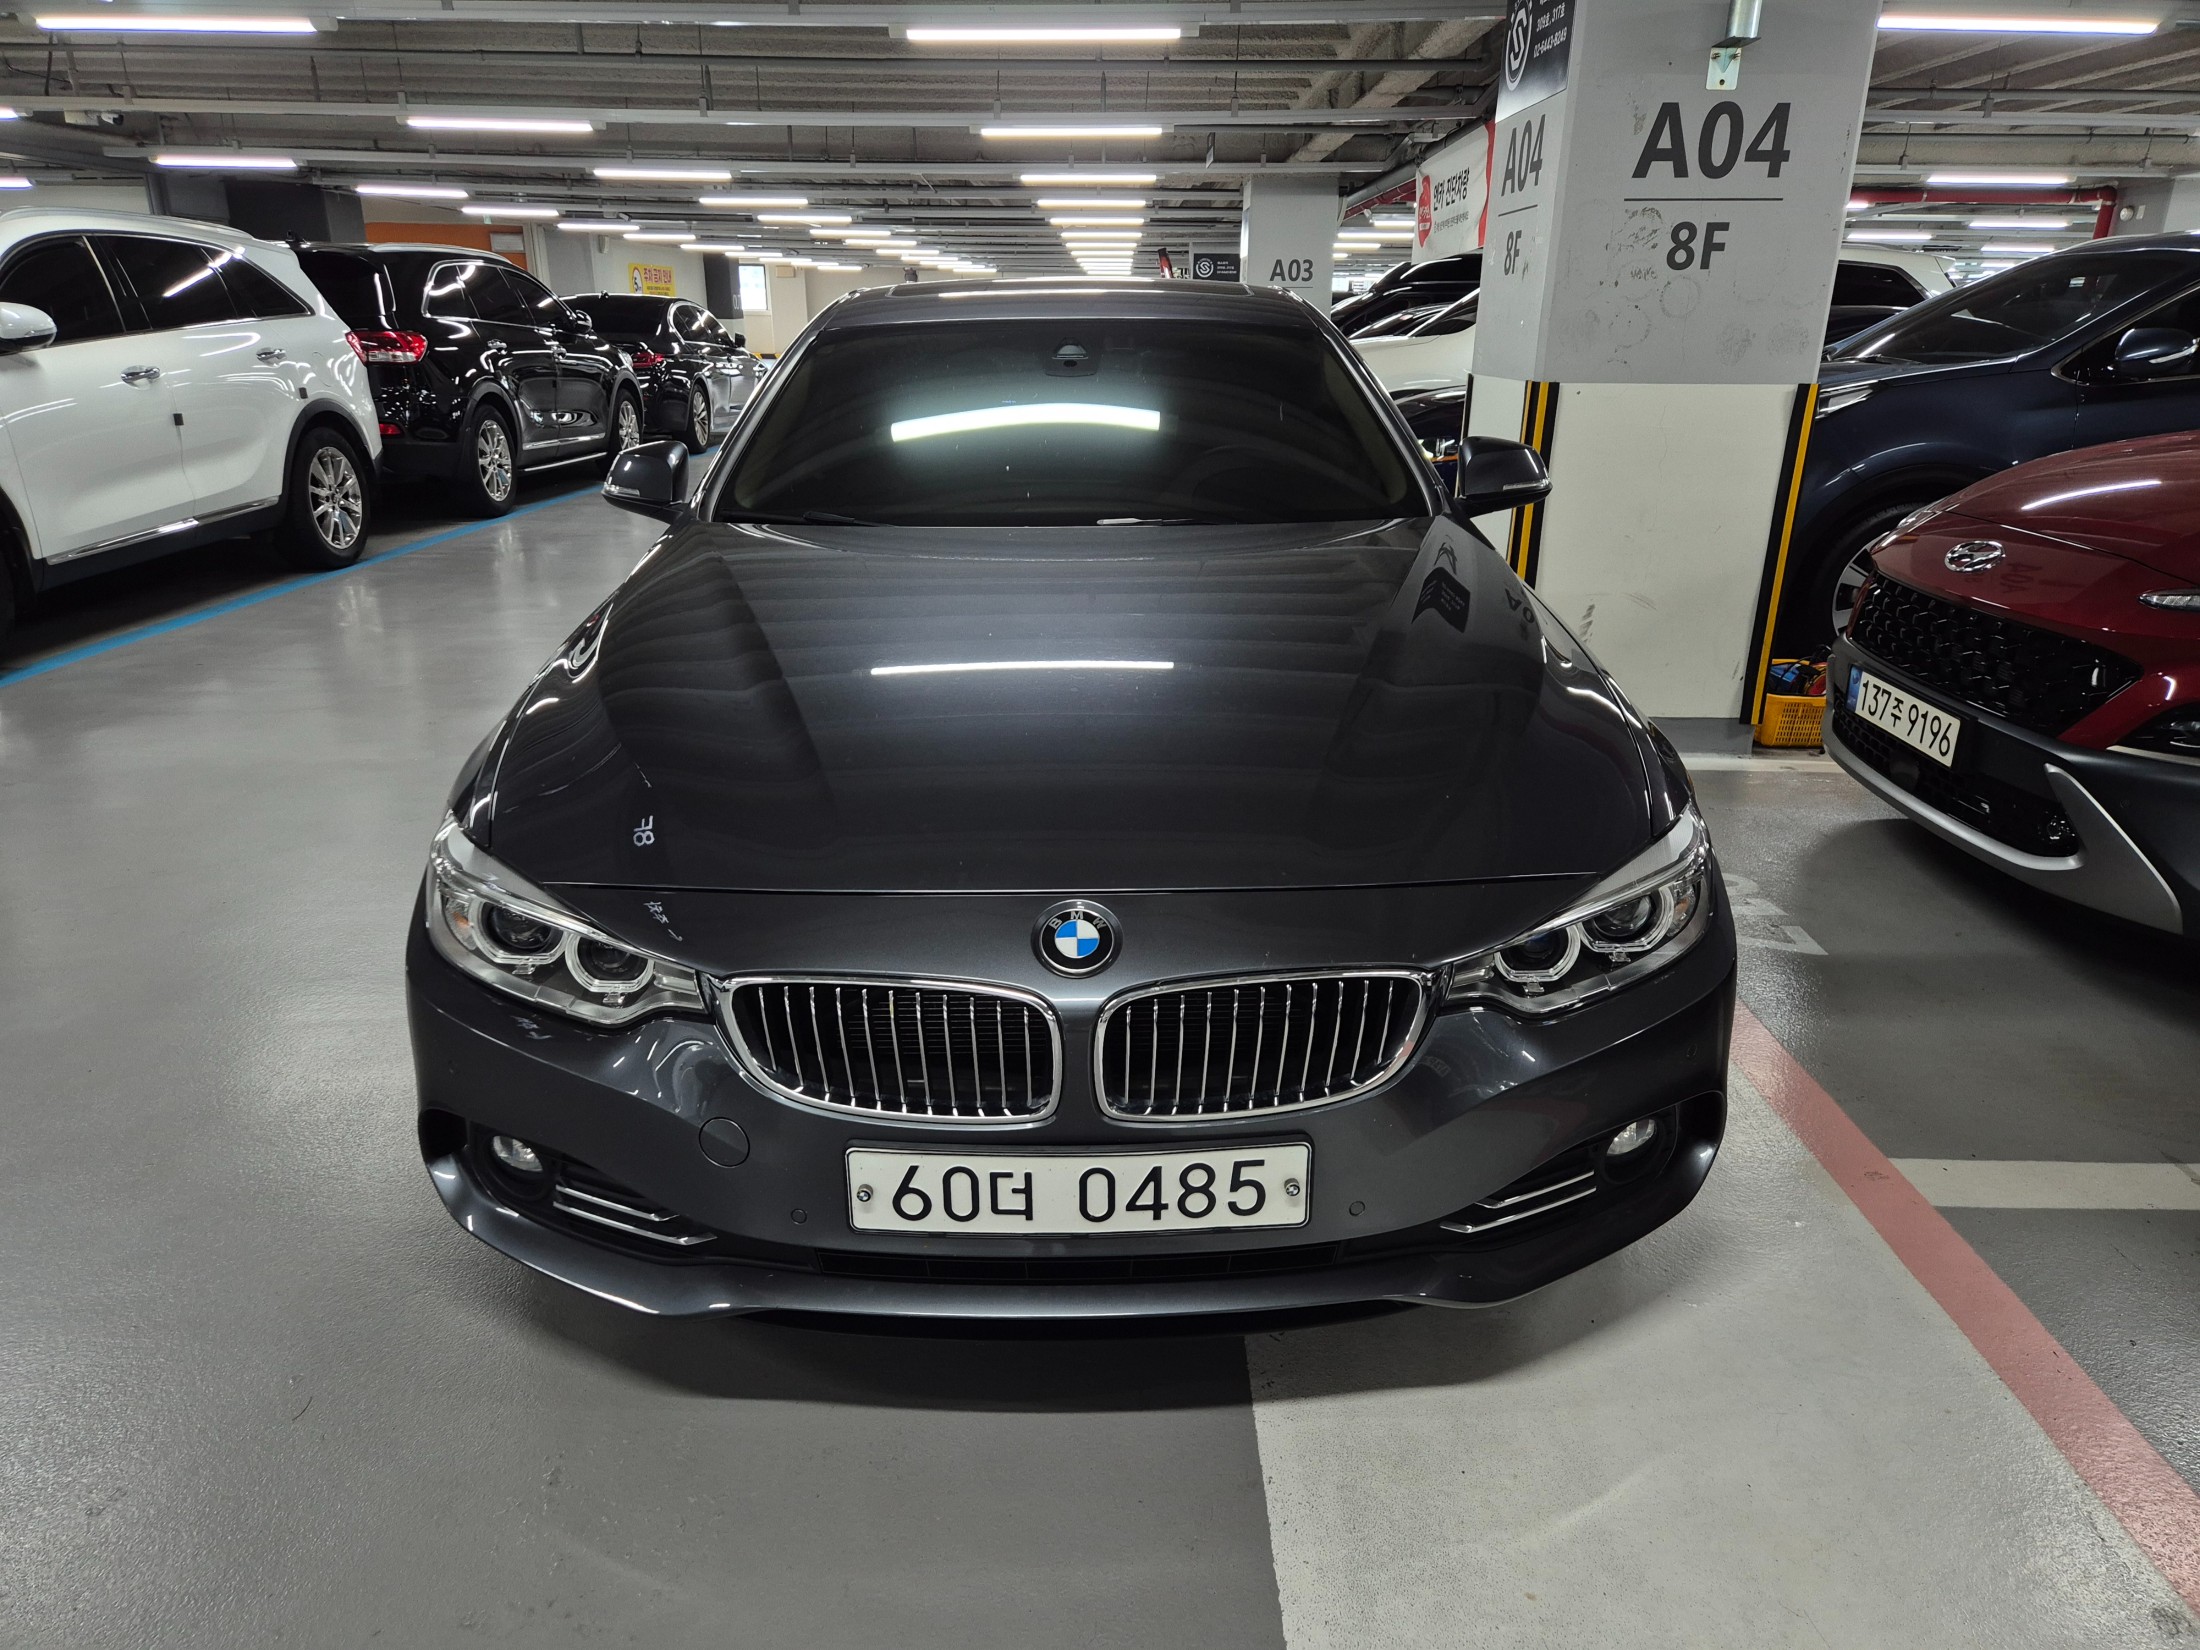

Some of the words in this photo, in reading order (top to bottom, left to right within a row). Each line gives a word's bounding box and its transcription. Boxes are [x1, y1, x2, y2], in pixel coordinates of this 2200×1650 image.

[1501, 113, 1547, 197] A04
[1632, 100, 1791, 179] A04
[1446, 167, 1470, 206] 진단차량
[1270, 258, 1314, 283] A03
[1503, 229, 1523, 277] 8F
[1666, 221, 1730, 271] 8F
[1861, 679, 1904, 728] 137주
[1907, 703, 1953, 757] 9196
[1048, 910, 1108, 930] BMW
[891, 1164, 1034, 1223] 60더
[1078, 1158, 1267, 1223] 0485
